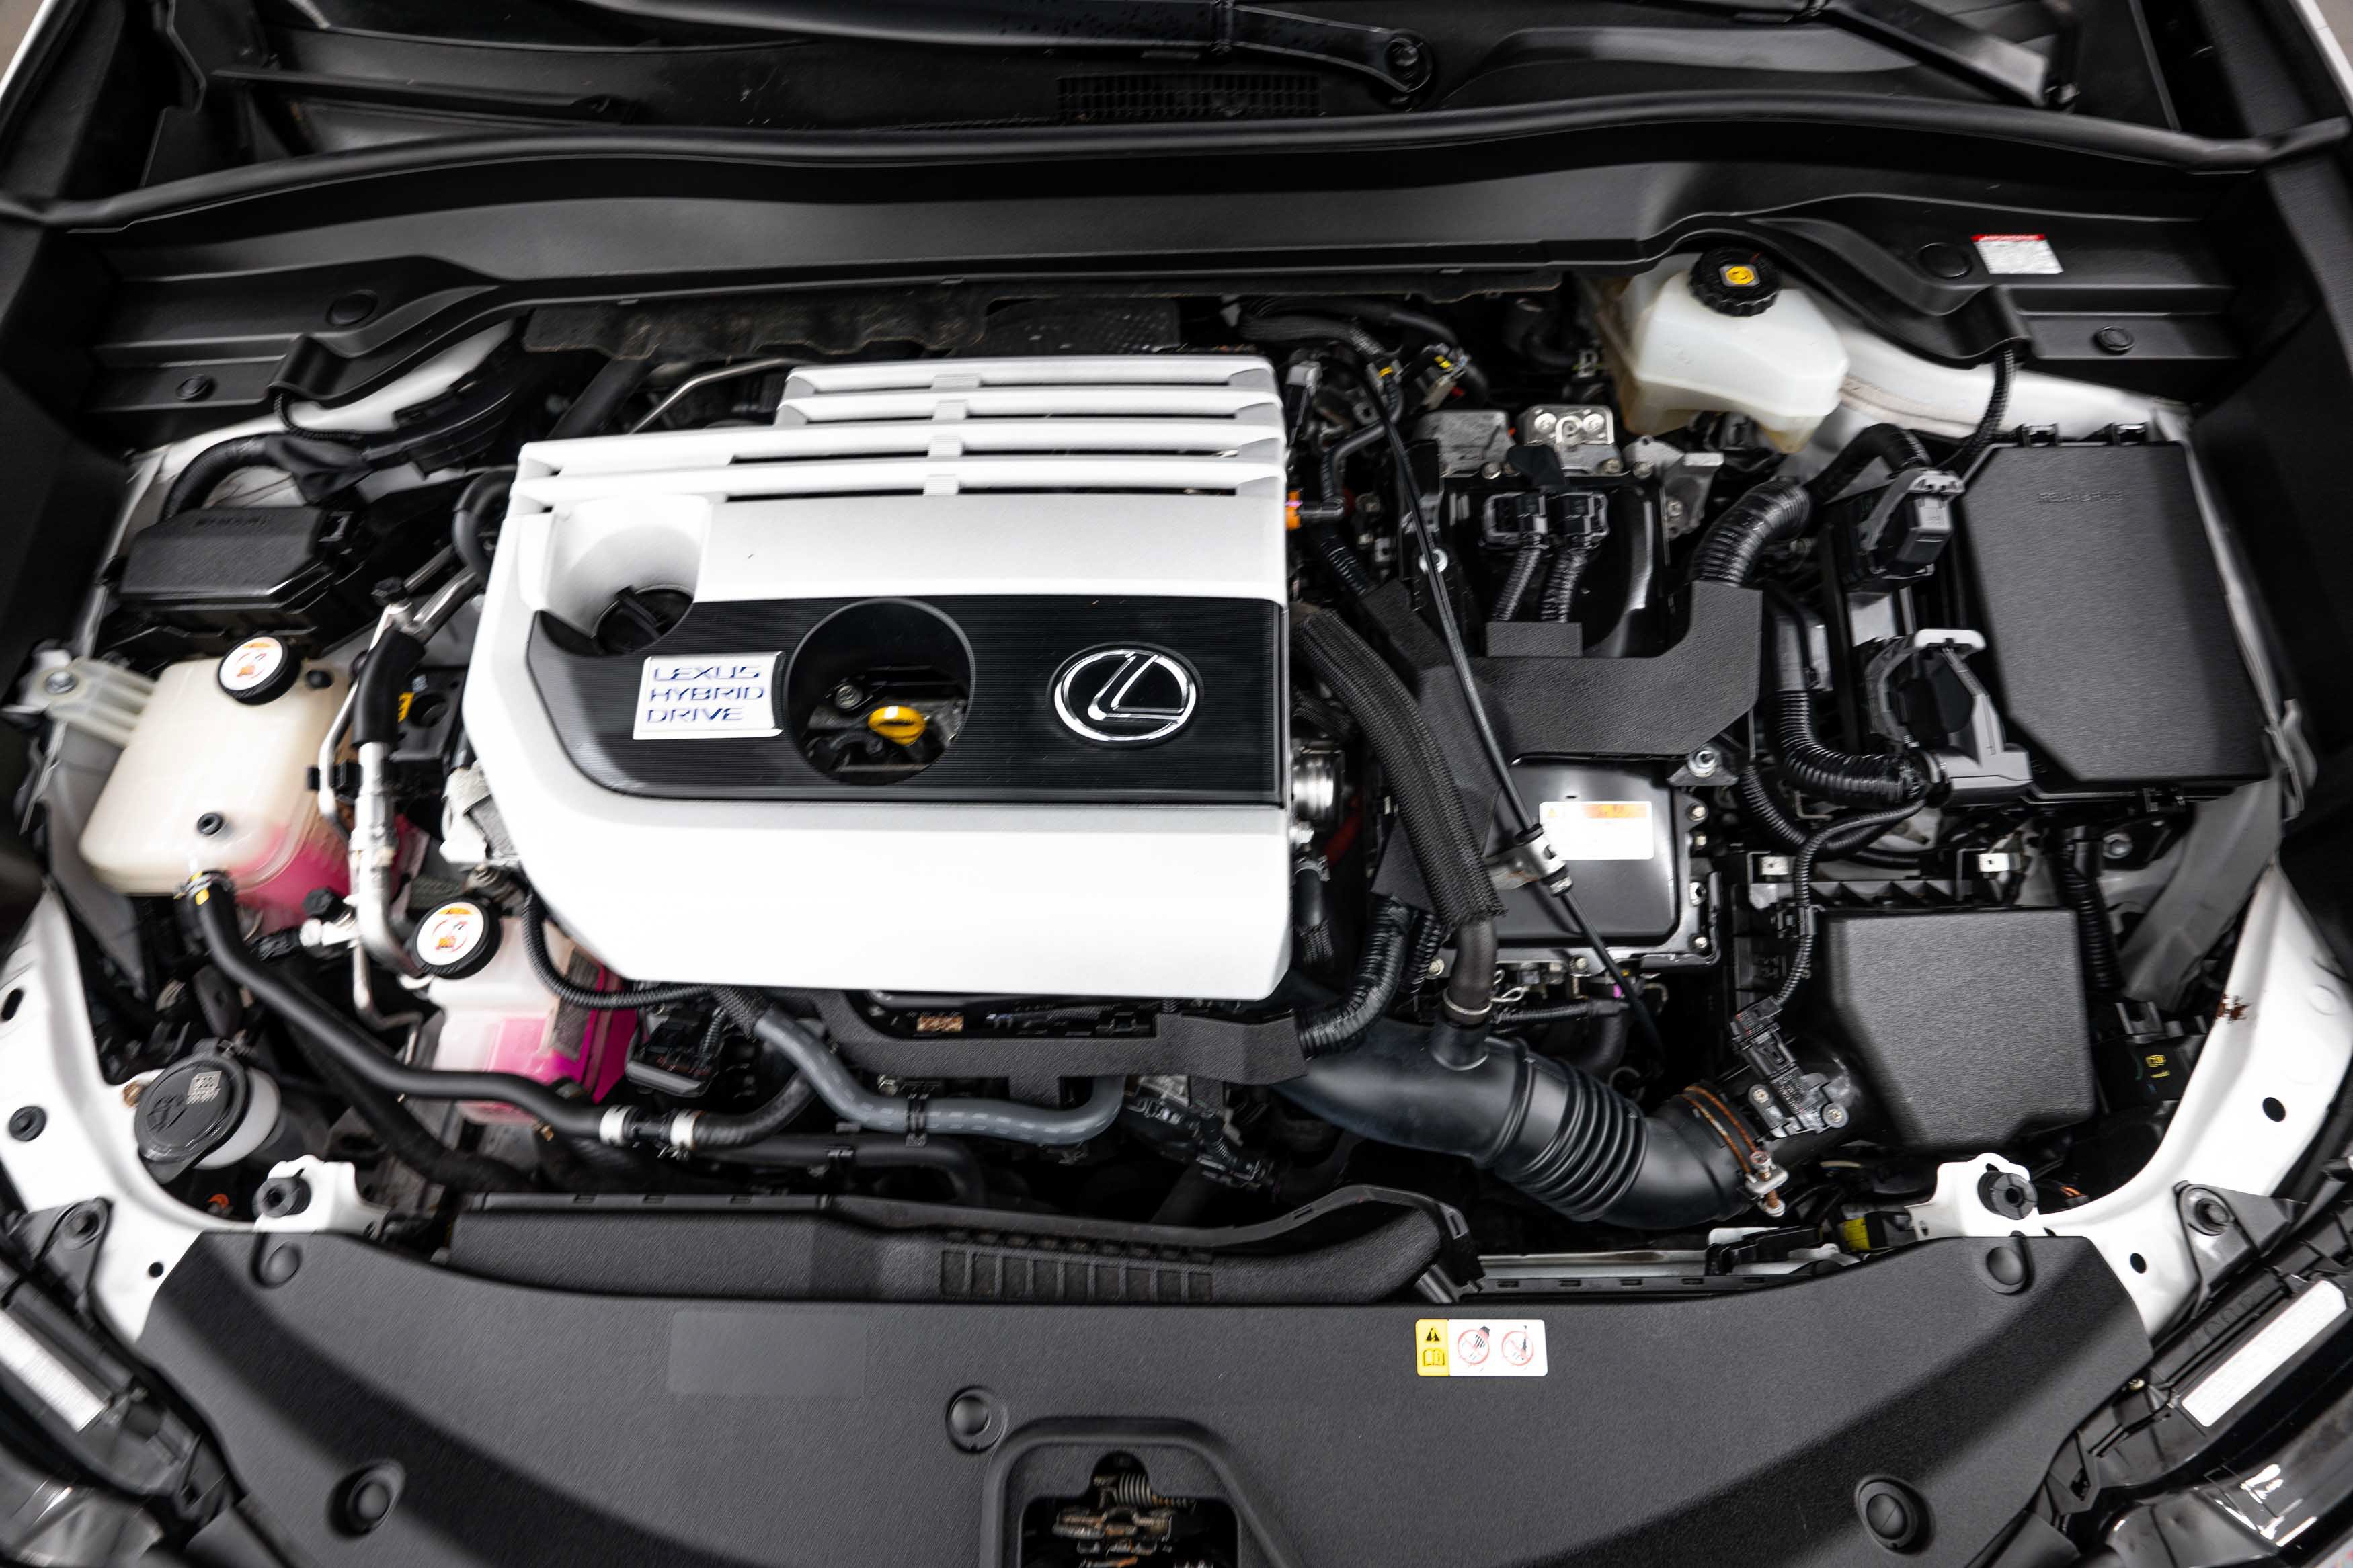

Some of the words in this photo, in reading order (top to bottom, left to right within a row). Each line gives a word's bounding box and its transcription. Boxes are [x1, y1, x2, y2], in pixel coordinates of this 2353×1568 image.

[654, 666, 761, 681] LEXUS
[650, 687, 764, 702] HYBRID
[647, 708, 744, 723] DRIVE
